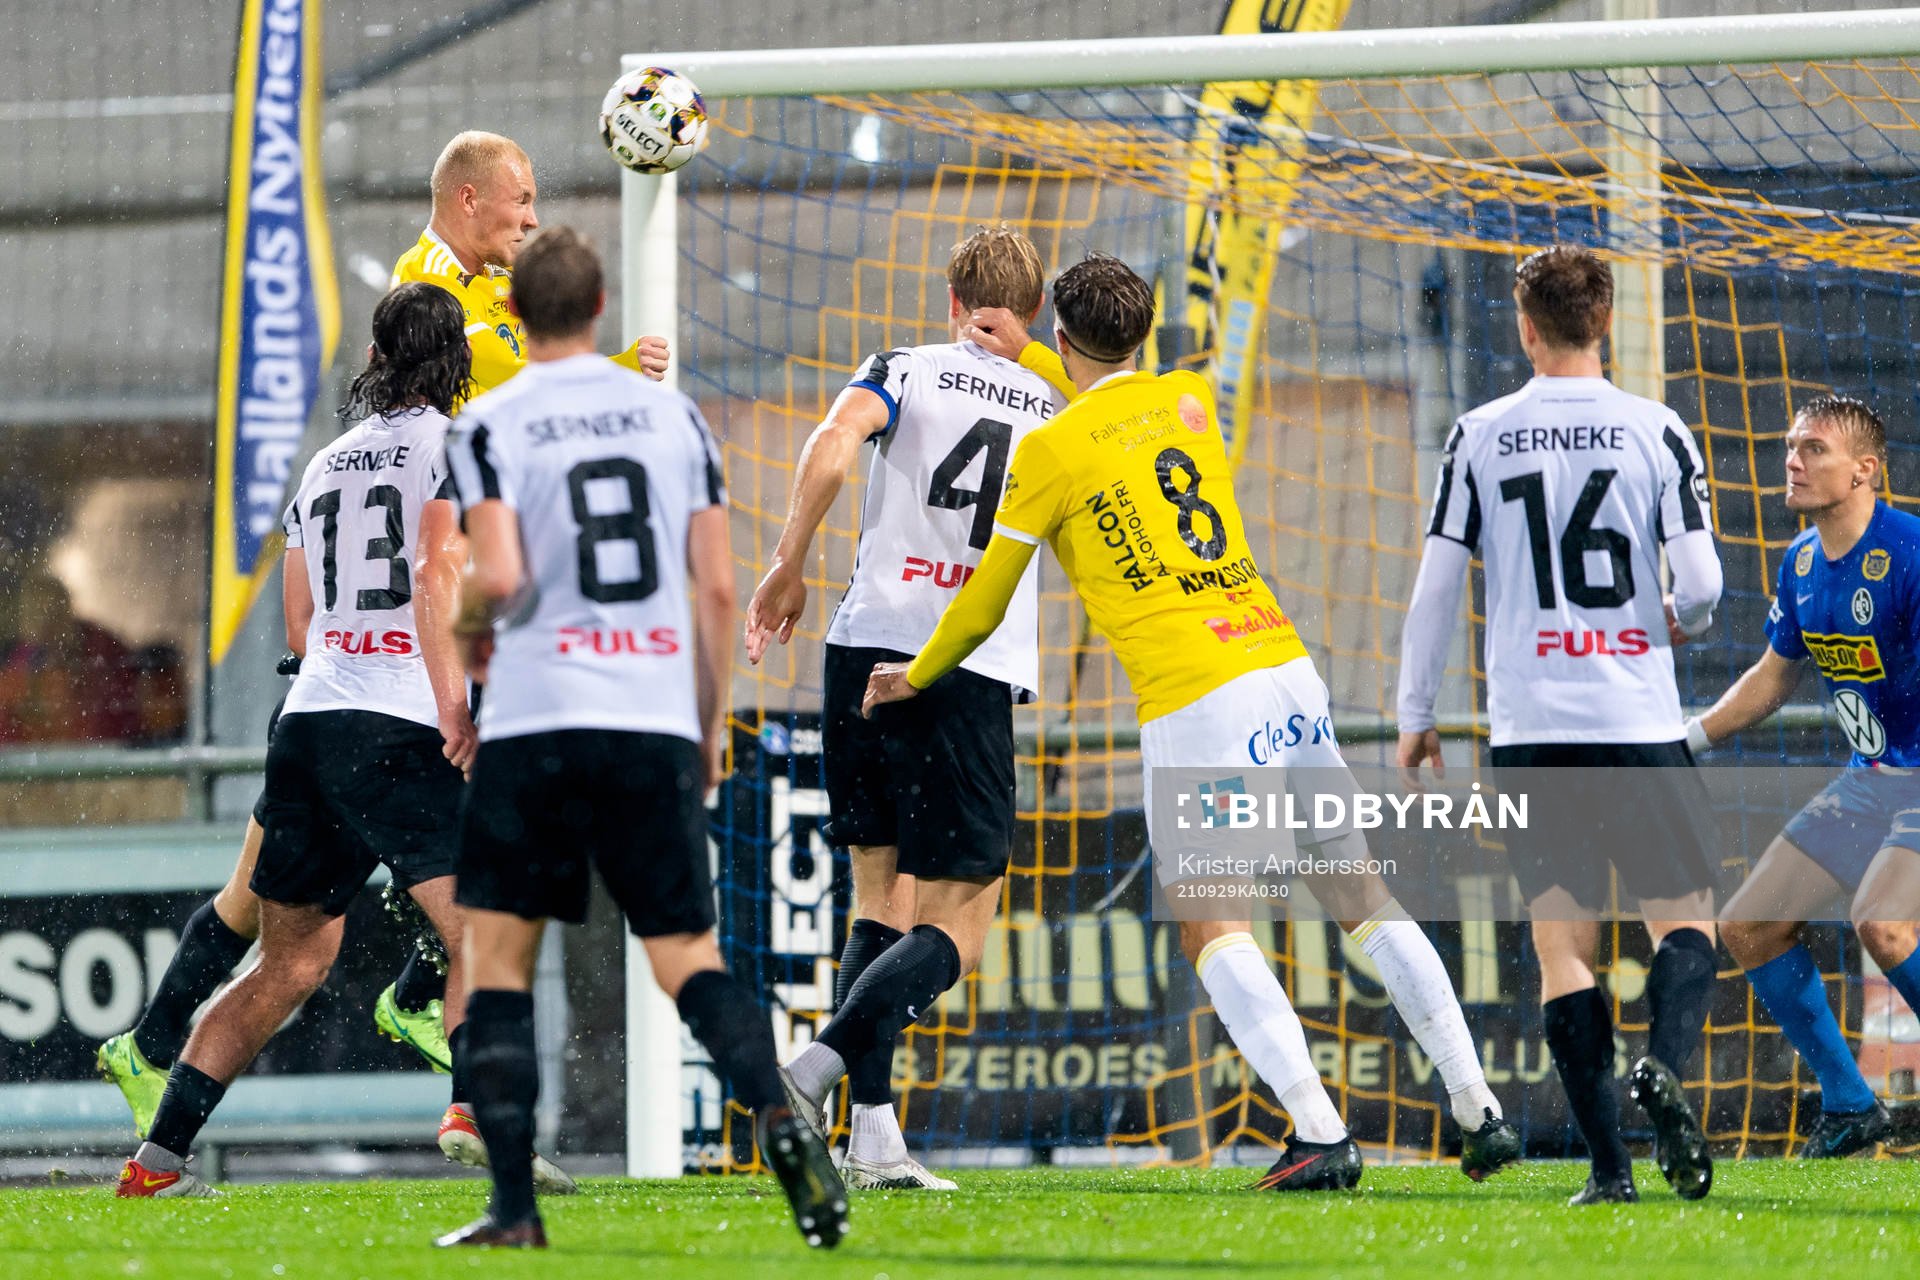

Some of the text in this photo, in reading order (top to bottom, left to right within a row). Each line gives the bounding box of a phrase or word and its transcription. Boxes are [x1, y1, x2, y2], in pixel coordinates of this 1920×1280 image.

[615, 113, 664, 155] SELECT
[938, 371, 1055, 420] SERNEKE
[524, 407, 655, 447] SERNEKE
[1498, 426, 1625, 457] SERNEKE
[325, 445, 410, 474] SERNEKE
[927, 417, 1013, 551] 4
[1155, 447, 1226, 562] 8
[309, 484, 412, 612] 13
[567, 457, 659, 603] 8
[1085, 490, 1155, 593] FALCON
[1111, 479, 1171, 578] ALKOHOLFRI
[1500, 469, 1636, 610] 16
[325, 630, 413, 655] PULS
[557, 626, 681, 656] PULS
[1536, 628, 1650, 658] PULS
[943, 1044, 1167, 1092] ZEROES
